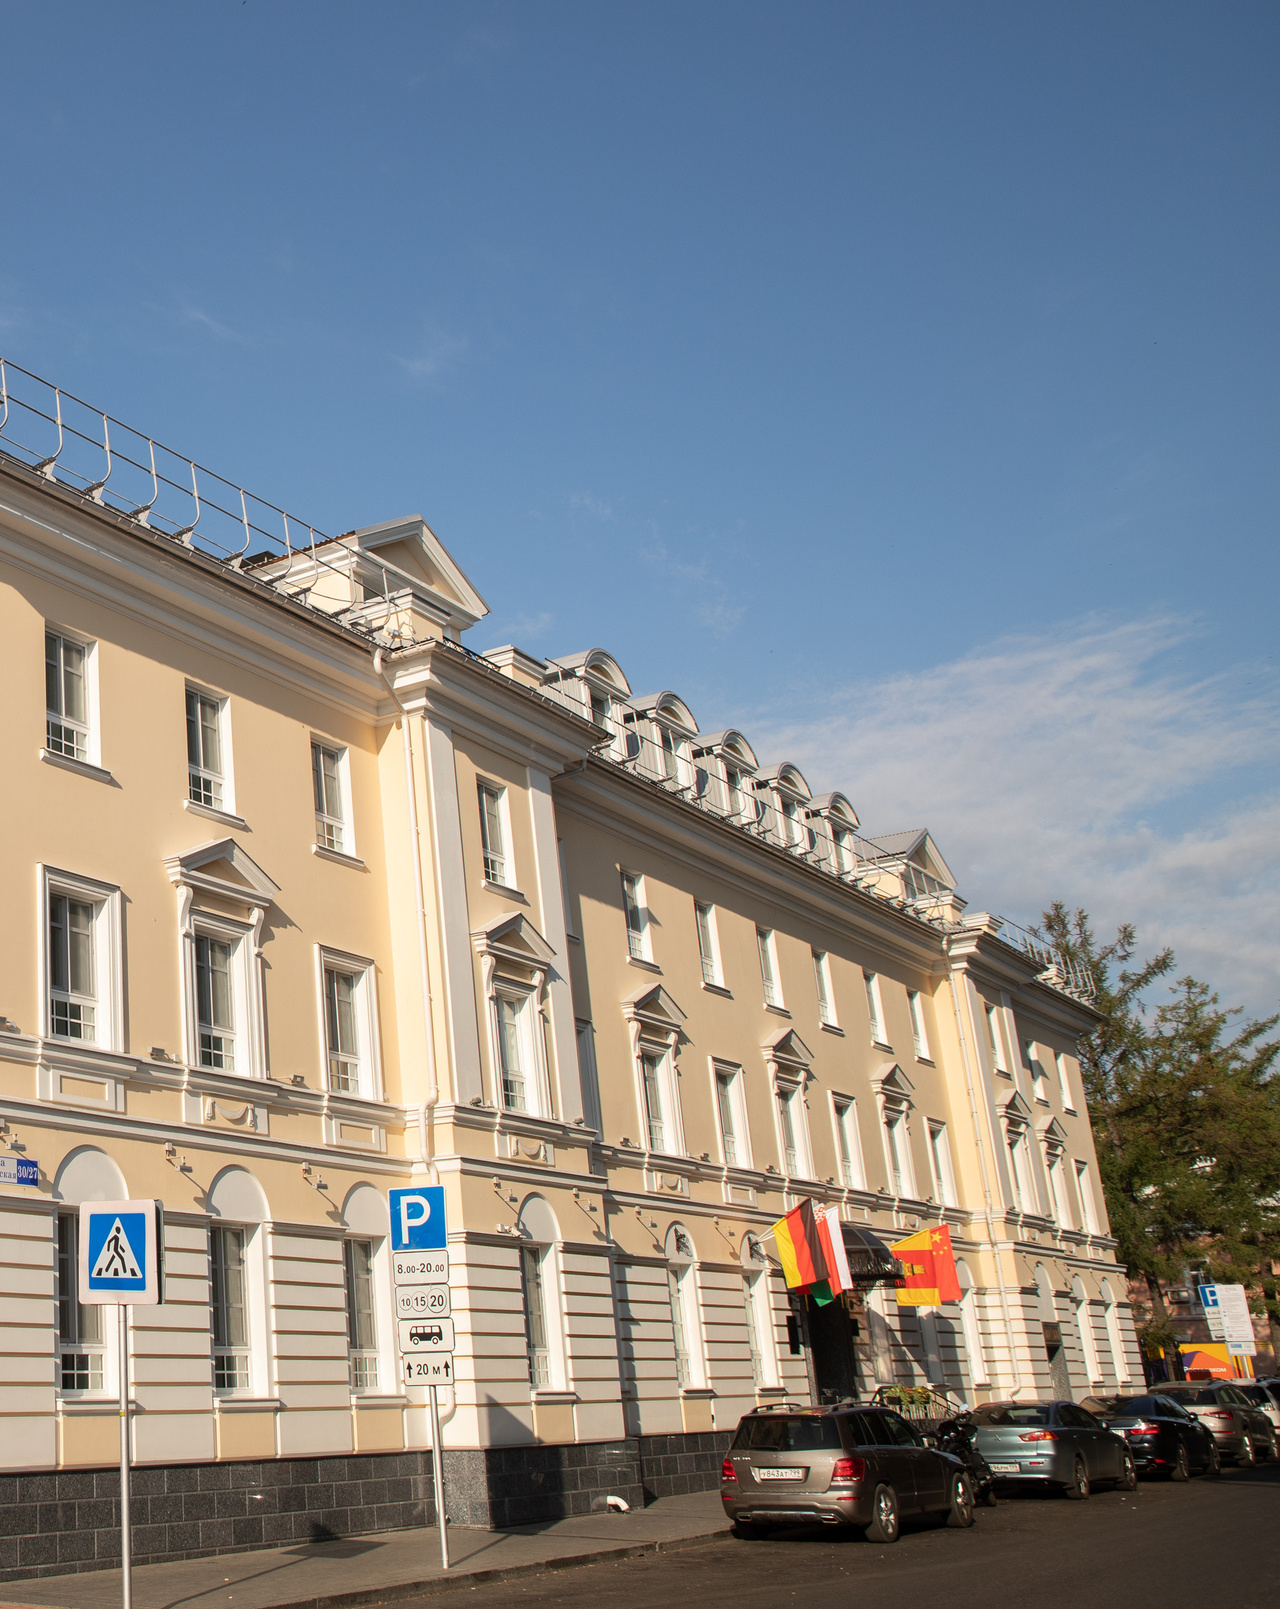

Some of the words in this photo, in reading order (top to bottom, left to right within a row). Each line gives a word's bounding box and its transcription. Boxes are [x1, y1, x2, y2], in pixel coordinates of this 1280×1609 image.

[17, 1165, 38, 1179] 30/27
[400, 1195, 431, 1245] P
[397, 1262, 445, 1274] 8.00-20.00
[401, 1298, 411, 1307] 10
[414, 1296, 426, 1307] 15
[430, 1294, 444, 1307] 20
[416, 1363, 429, 1376] 20
